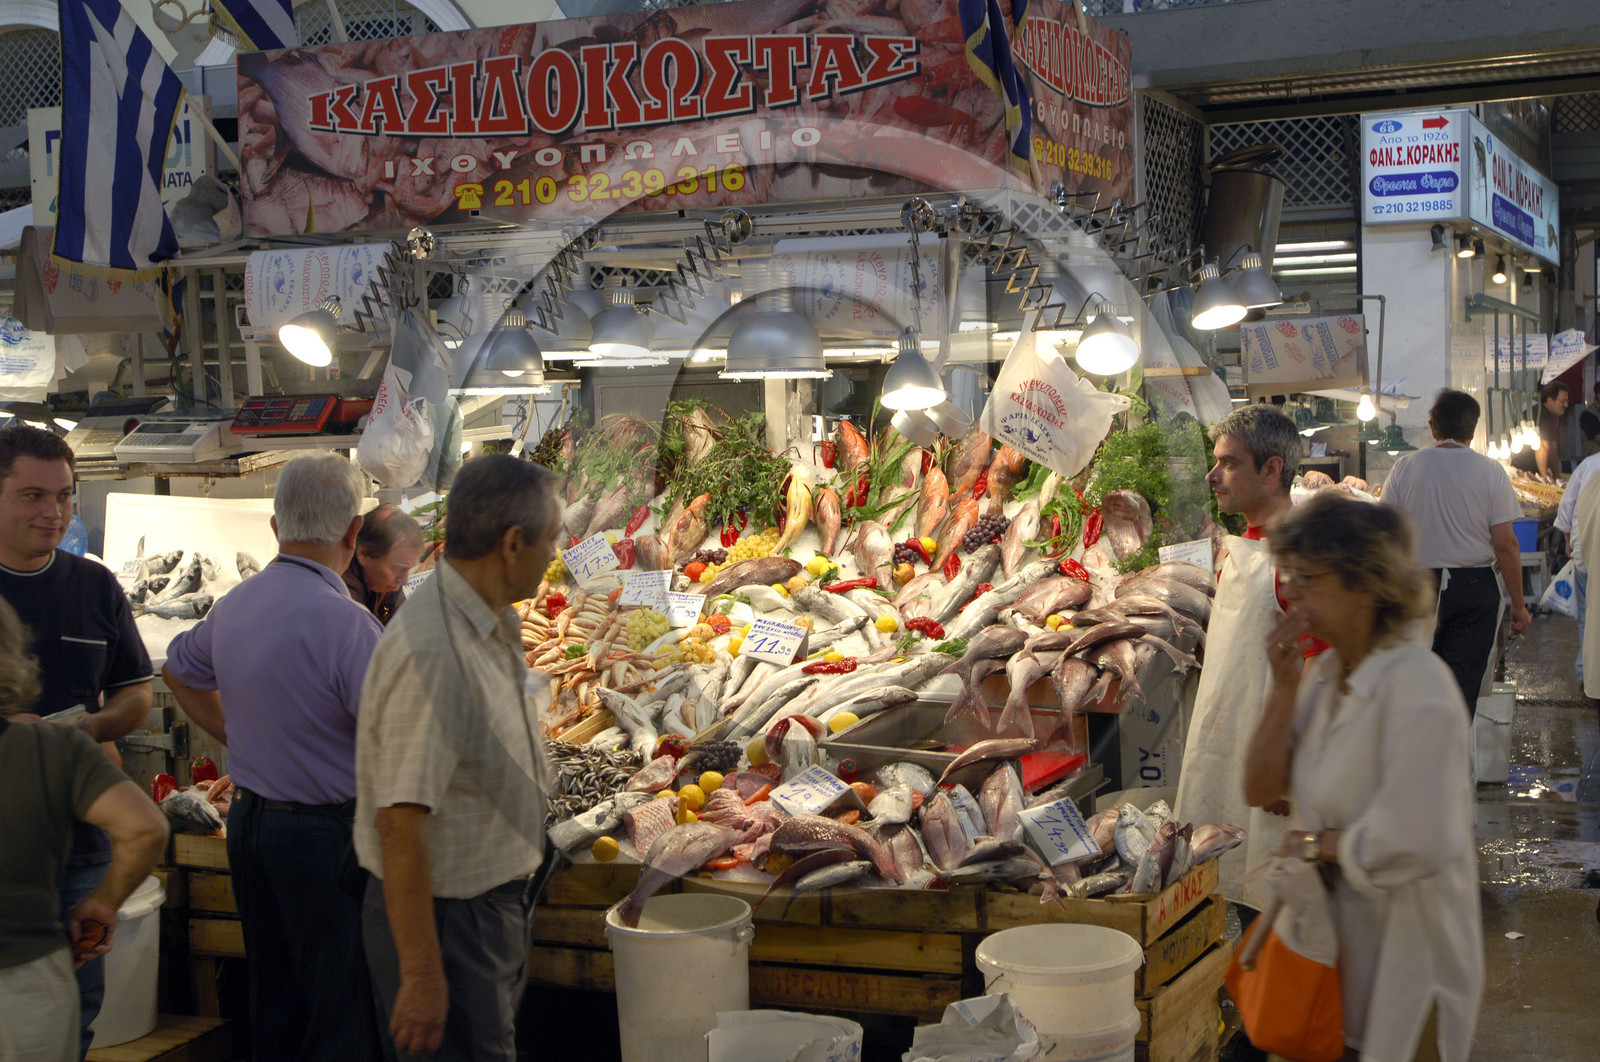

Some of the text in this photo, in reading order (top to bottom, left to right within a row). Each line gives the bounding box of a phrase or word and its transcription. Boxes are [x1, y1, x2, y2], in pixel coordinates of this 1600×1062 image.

[308, 33, 918, 136] ΚΑΣΙΔΟΚΩΣΤΑΣ
[1029, 97, 1125, 150] ΘΥΟΠΩΛΕΙΟ
[1380, 125, 1394, 133] 68
[1423, 132, 1449, 141] 1926
[384, 126, 822, 179] ΙΧΘΥΟΠΩΛΕΙΟ
[1046, 139, 1113, 182] 210 32.39.316
[494, 163, 747, 207] 210 32.39.316
[1315, 321, 1338, 364] ΧΘΥΟΠΩΛΕΙΟ
[1010, 392, 1065, 430] ΚΑΣΙΔΟΚΩΣΤΑΣ
[1174, 870, 1204, 912] ΝΙΚΑΣ
[751, 971, 882, 1002] ΦΡΟΔΙΤΗ
